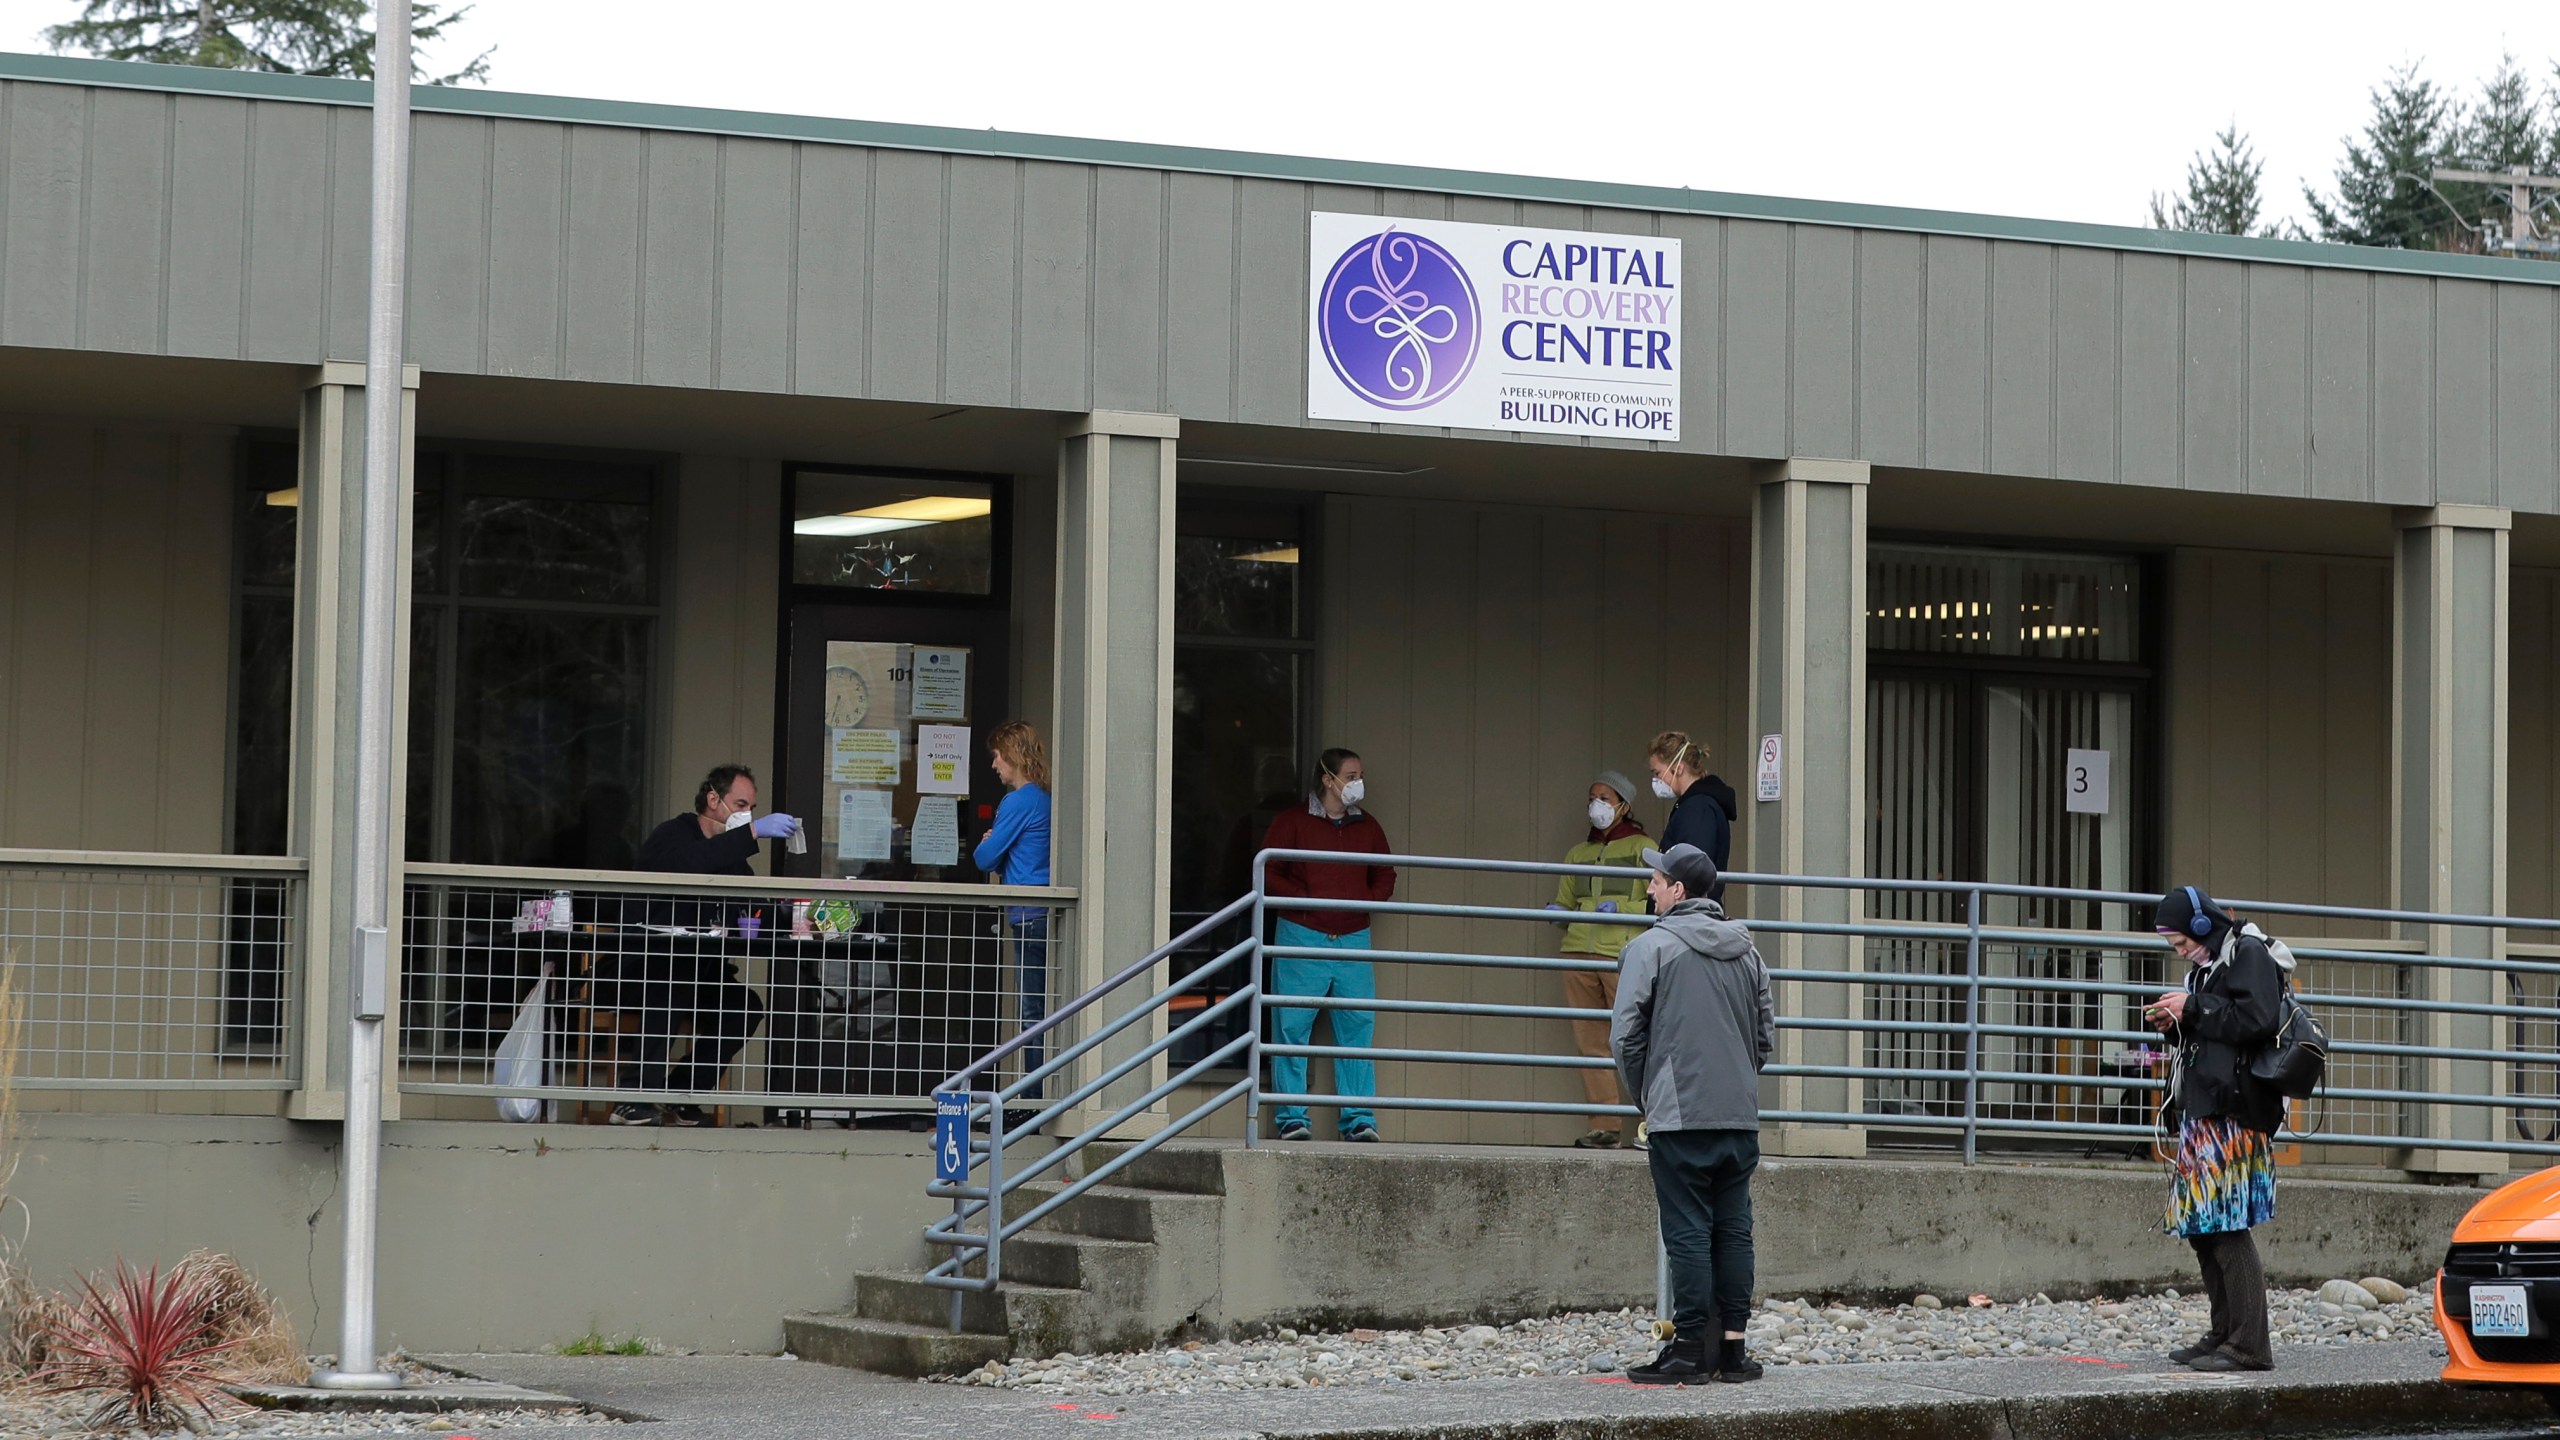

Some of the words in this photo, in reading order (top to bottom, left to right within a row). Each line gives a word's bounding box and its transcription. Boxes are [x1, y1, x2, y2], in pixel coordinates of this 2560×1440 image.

[1502, 239, 1674, 289] CAPITAL
[1502, 283, 1674, 324] RECOVERY
[1502, 320, 1673, 371] CENTER
[1500, 386, 1508, 397] A
[1510, 387, 1600, 403] PEER-SUPPORTED
[1603, 393, 1674, 407] COMMUNITY
[1501, 400, 1608, 426] BUILDING
[1615, 408, 1673, 431] HOPE
[887, 668, 913, 682] 101
[2073, 766, 2088, 793] 3
[938, 1101, 961, 1116] Entrance
[2474, 1303, 2523, 1327] BPB2460
